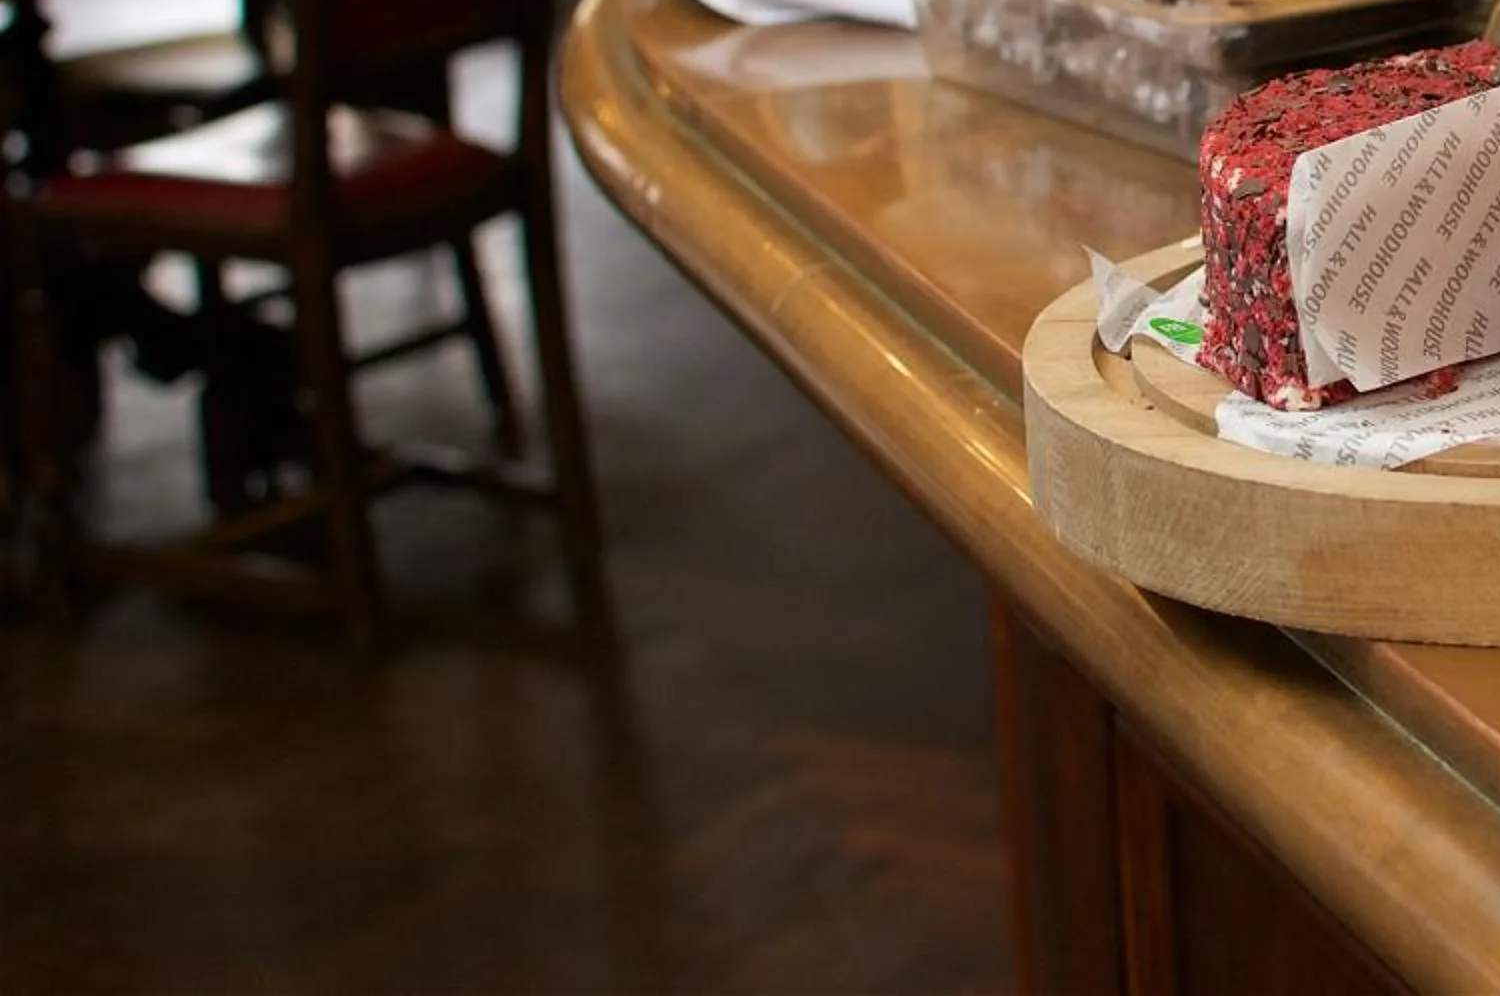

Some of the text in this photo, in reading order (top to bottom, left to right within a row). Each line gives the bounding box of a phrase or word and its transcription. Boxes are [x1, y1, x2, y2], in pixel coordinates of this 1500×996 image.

[1339, 203, 1378, 252] HALL
[1348, 131, 1461, 314] HALL & WOODHOUSE
[1395, 256, 1432, 306] HALL
[1424, 253, 1479, 359] WOODHOUSE
